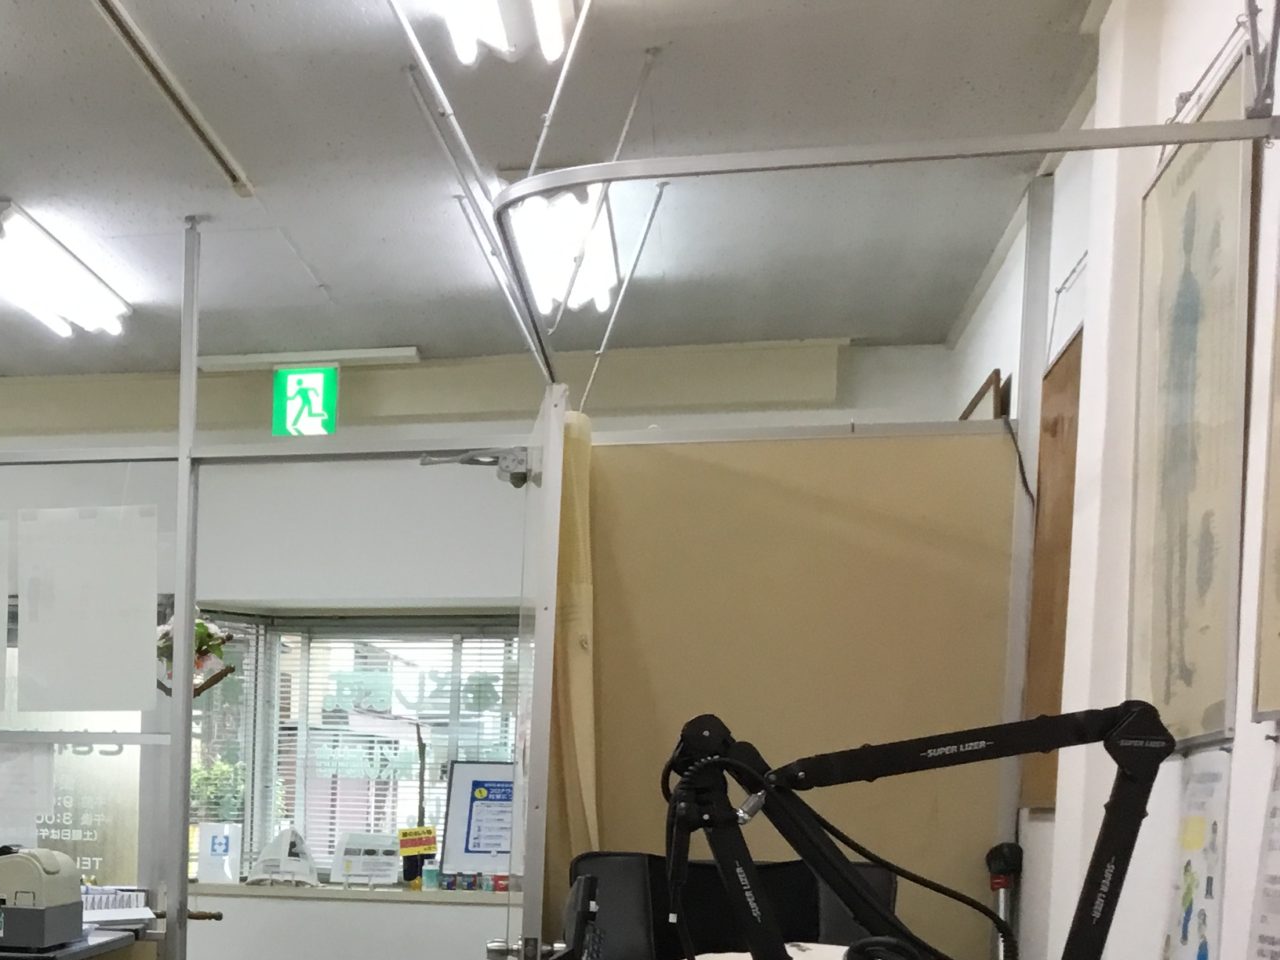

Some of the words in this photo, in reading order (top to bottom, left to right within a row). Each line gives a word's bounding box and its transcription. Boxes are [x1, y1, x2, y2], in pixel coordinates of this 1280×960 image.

[927, 745, 958, 758] SUPER
[959, 740, 987, 752] LIZER
[735, 866, 751, 890] LIZER
[1099, 862, 1116, 892] SUPER
[745, 890, 762, 917] SUPER
[1091, 892, 1107, 919] LIZER
